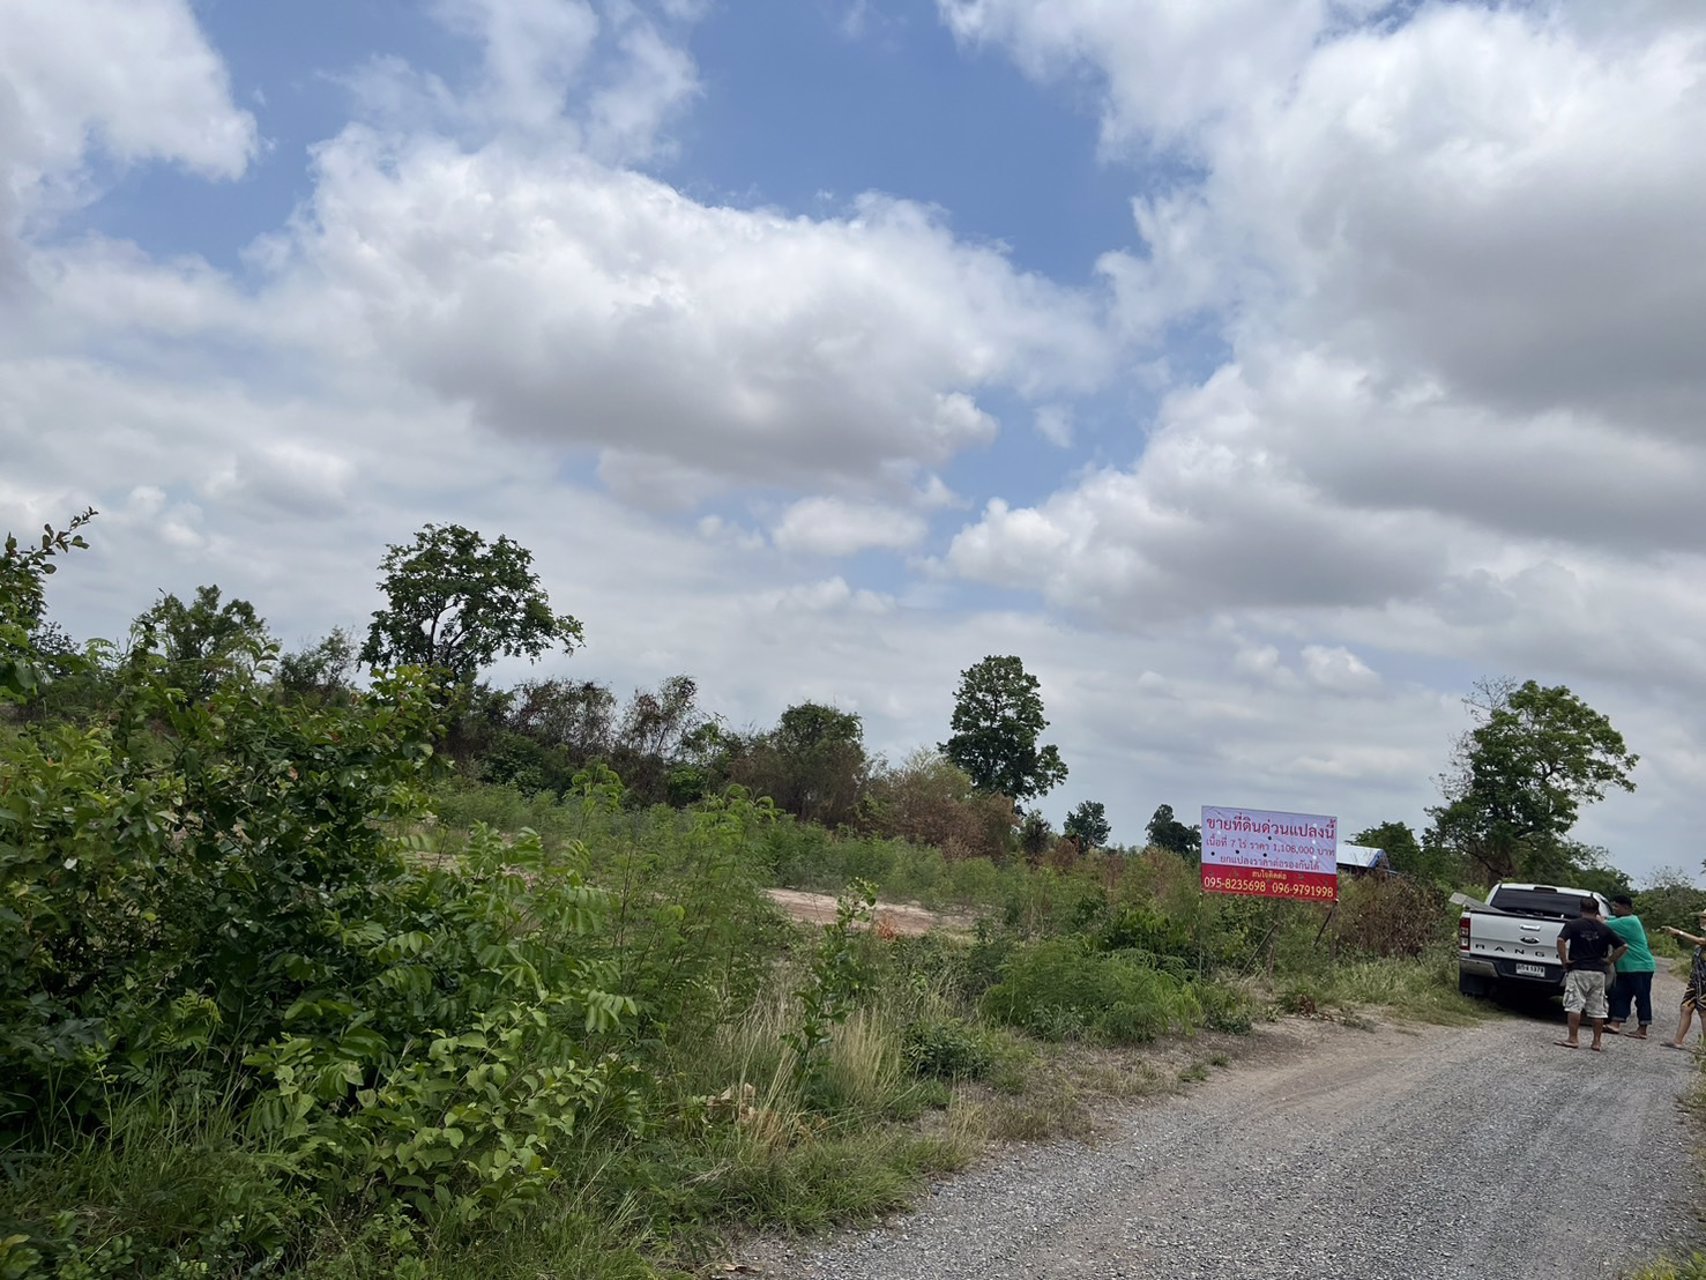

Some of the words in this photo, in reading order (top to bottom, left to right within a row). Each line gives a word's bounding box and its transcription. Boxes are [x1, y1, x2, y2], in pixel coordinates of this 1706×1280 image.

[1206, 813, 1336, 840] ขายที่ดินด่วนแปลงนี้
[1250, 842, 1270, 851] ราคา
[1204, 876, 1266, 892] 095-8235698
[1272, 882, 1334, 898] 096-9791998
